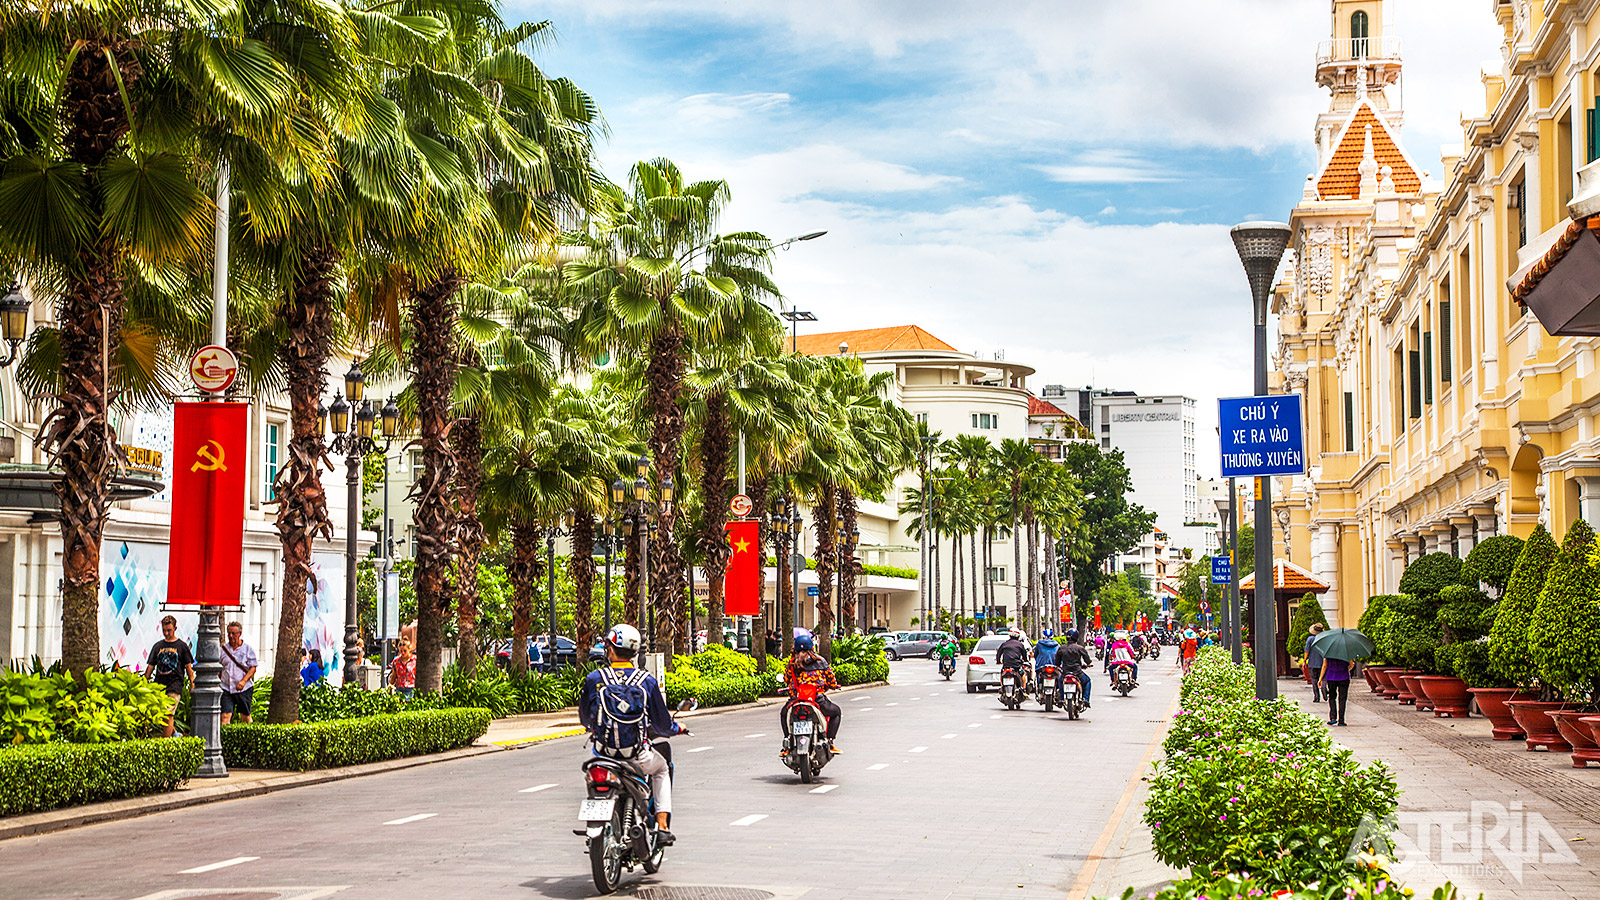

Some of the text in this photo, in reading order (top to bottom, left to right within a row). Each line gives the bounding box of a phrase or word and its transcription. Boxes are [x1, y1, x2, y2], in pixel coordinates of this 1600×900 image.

[1112, 412, 1180, 422] LIBERTY CENTRAL
[1240, 400, 1280, 421] CHÚ Ý
[1232, 424, 1289, 444] XE RA VÀO
[1222, 447, 1301, 469] THƯỜNG XUYÊN
